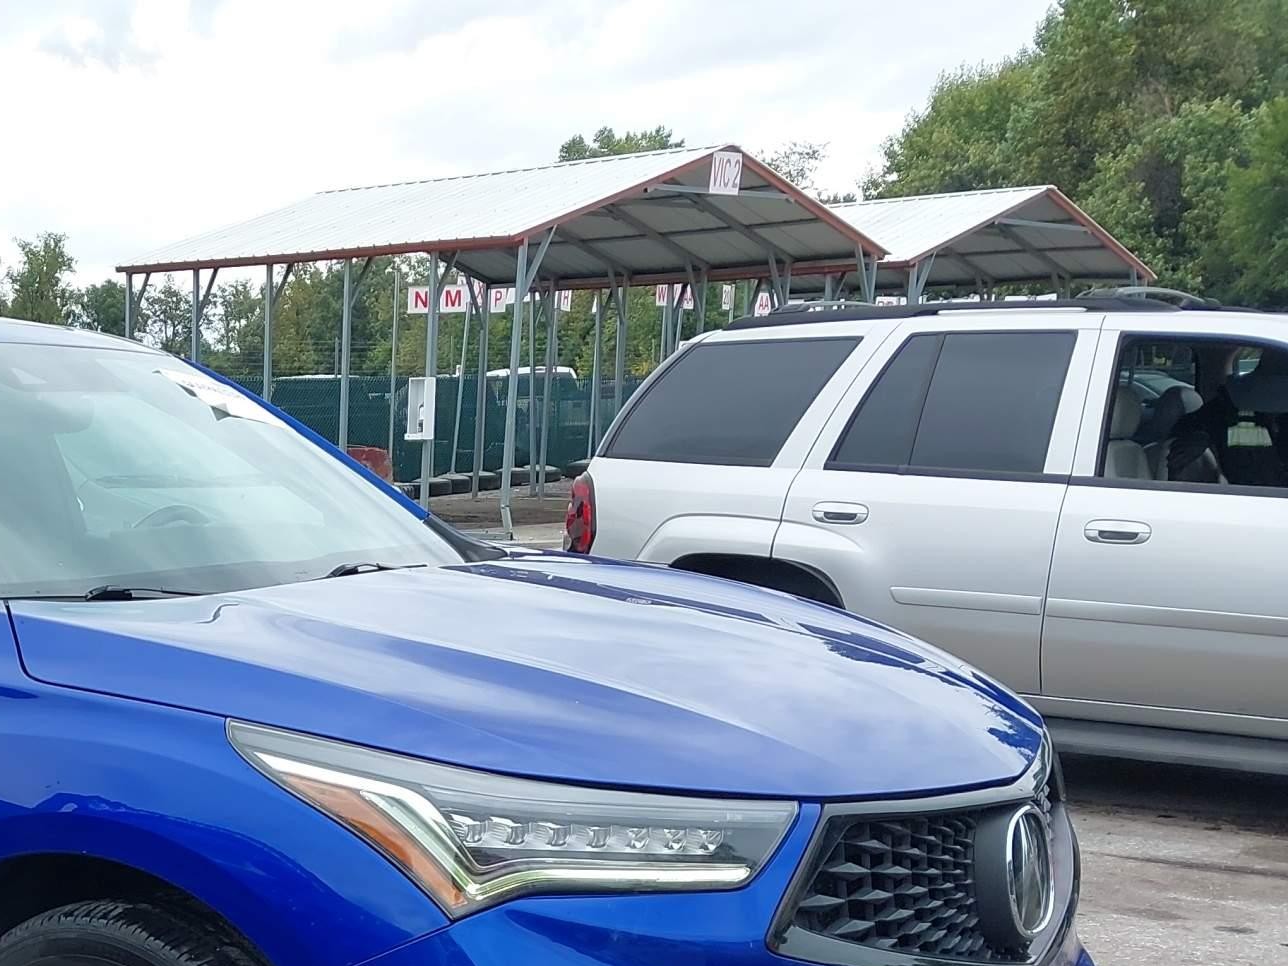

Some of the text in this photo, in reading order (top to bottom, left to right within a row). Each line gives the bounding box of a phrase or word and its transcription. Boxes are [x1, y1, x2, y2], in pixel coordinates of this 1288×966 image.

[713, 157, 741, 189] VIC 2
[414, 290, 429, 309] N
[444, 289, 462, 308] M
[494, 290, 503, 308] P
[657, 286, 668, 303] W
